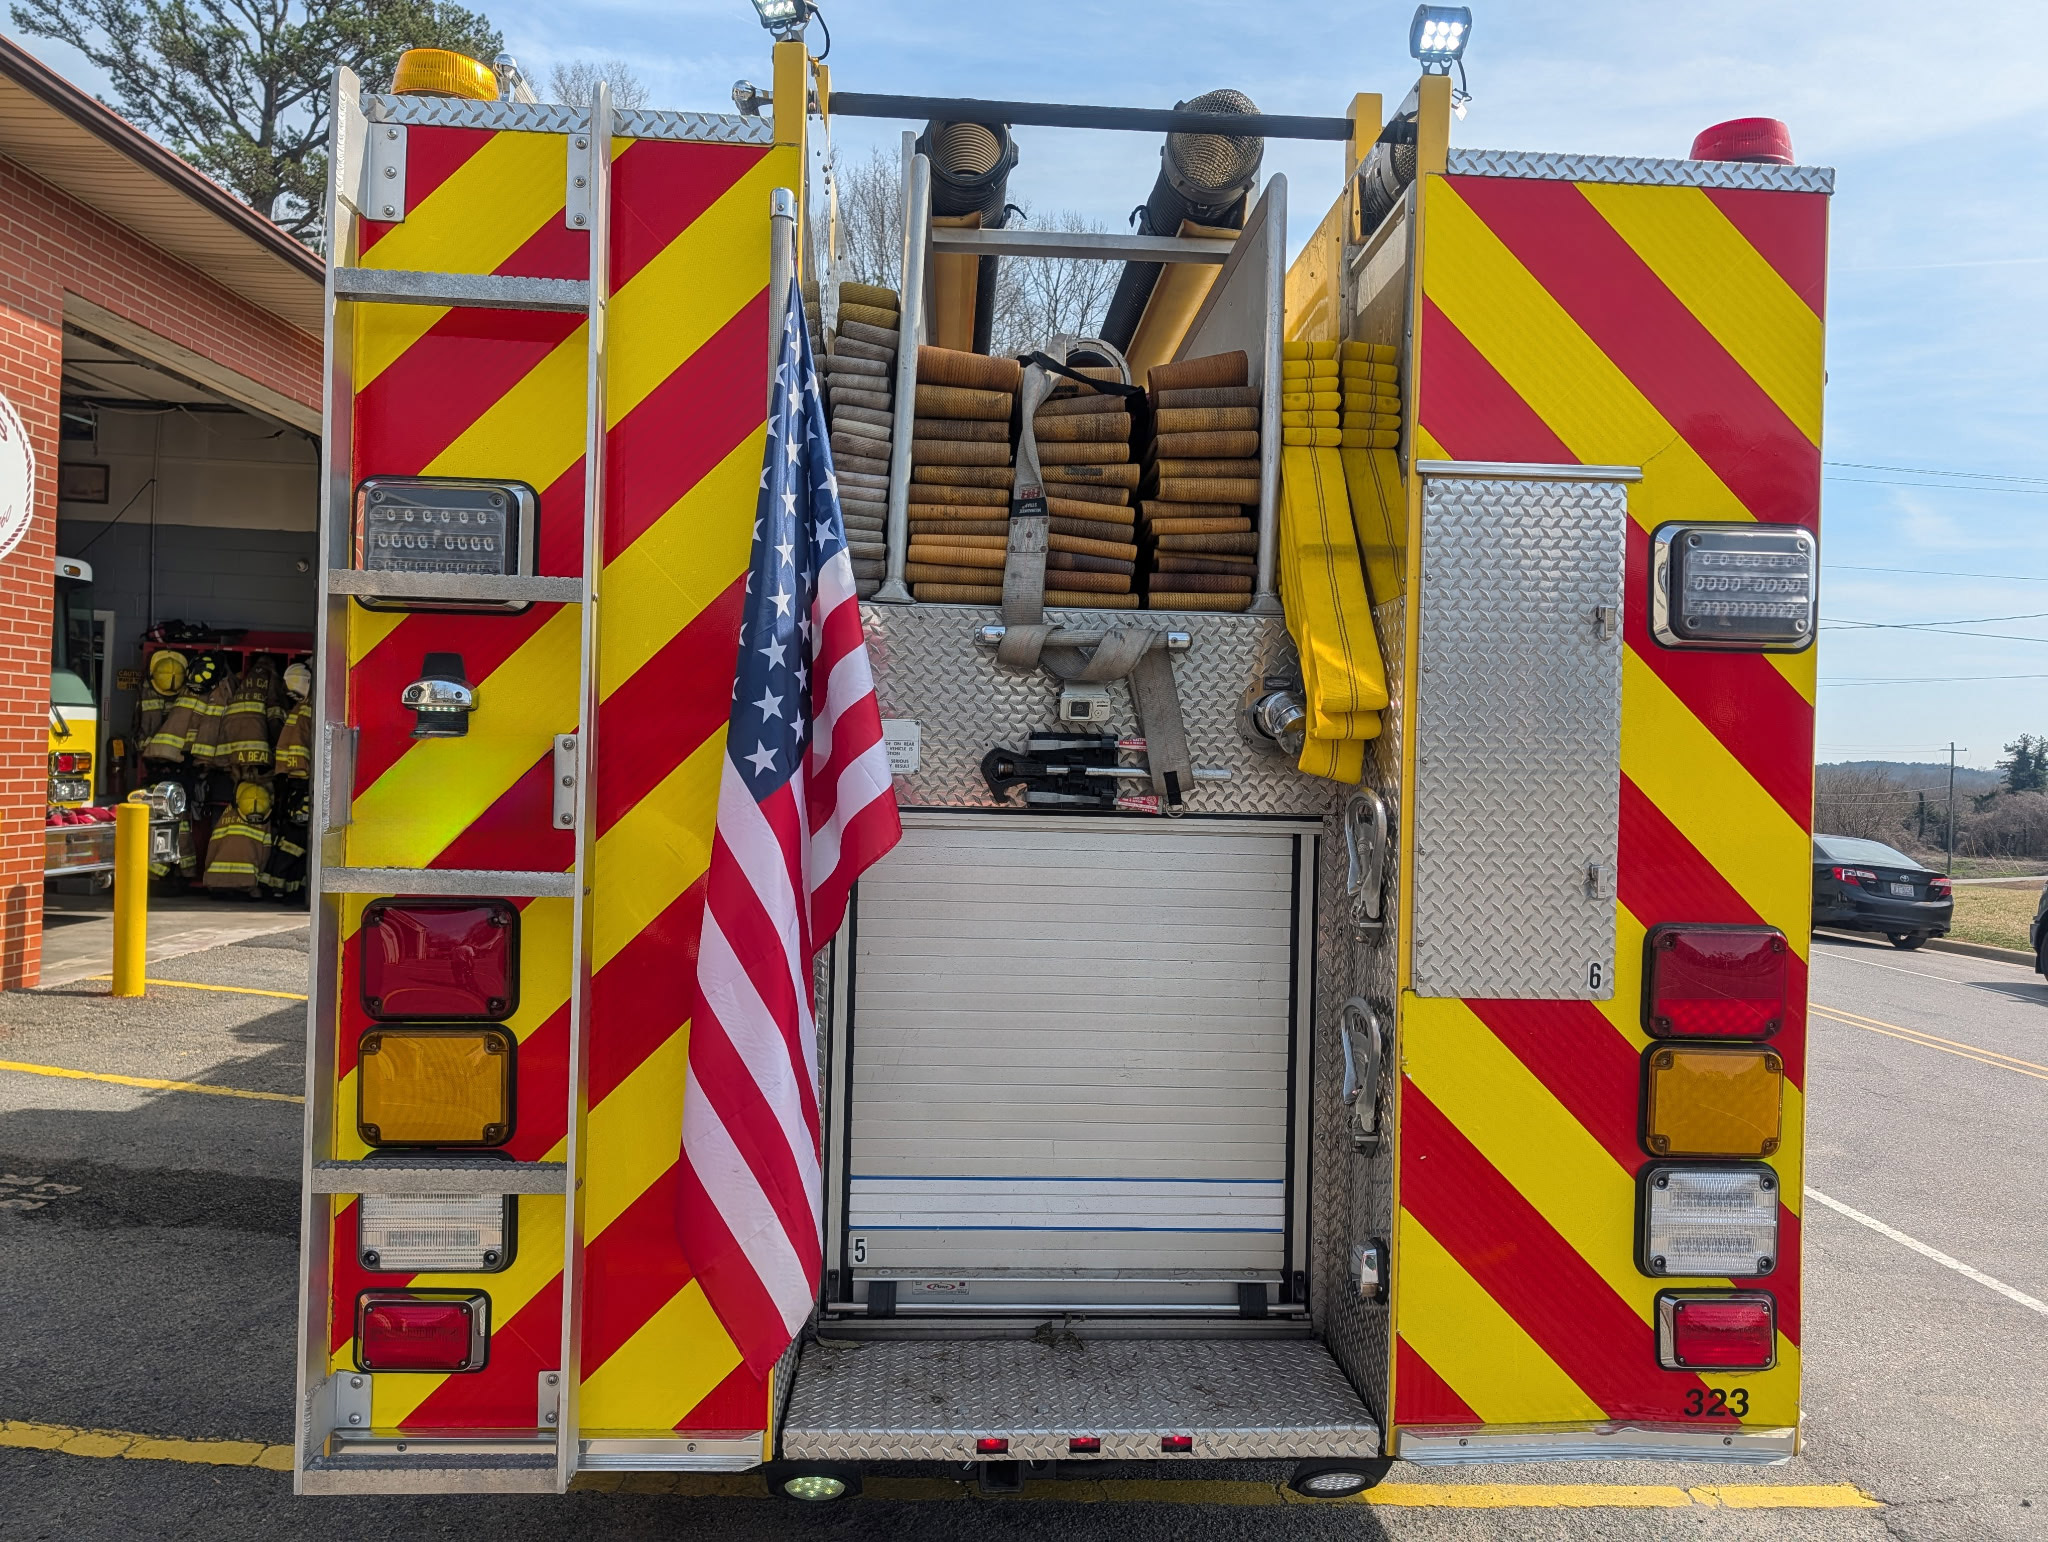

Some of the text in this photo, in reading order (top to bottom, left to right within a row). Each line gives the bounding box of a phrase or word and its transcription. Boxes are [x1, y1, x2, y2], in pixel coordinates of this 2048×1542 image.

[1589, 962, 1602, 990] 6
[854, 1238, 866, 1263] 5
[1683, 1387, 1750, 1418] 323
